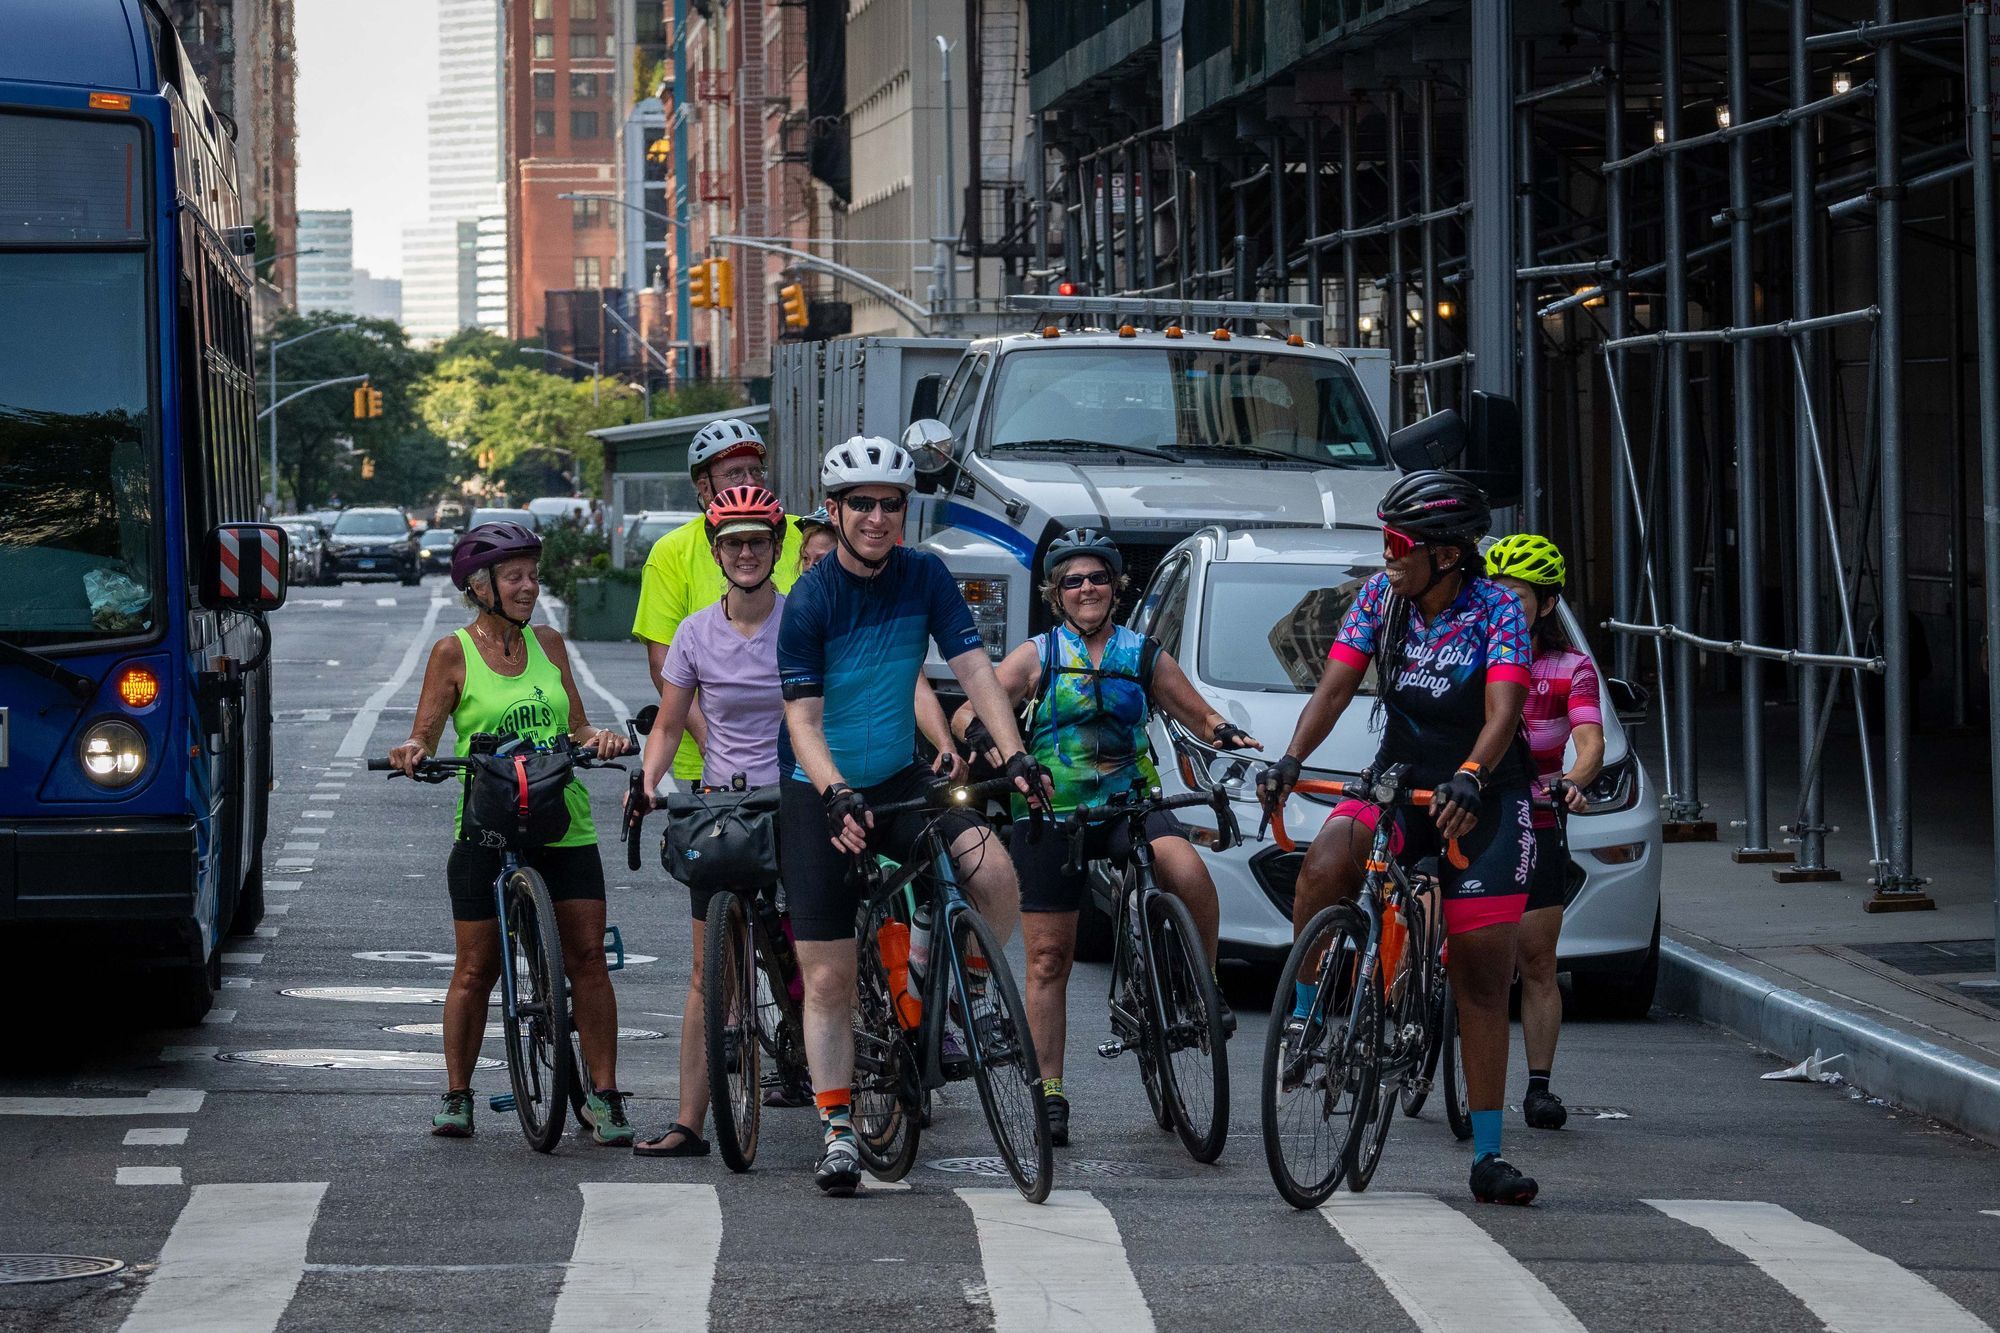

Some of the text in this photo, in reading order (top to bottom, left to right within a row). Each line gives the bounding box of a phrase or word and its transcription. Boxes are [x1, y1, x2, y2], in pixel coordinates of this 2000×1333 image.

[1435, 645, 1473, 670] Girl
[1395, 668, 1451, 698] ycling
[505, 704, 551, 733] GIRLS
[1514, 799, 1534, 885] Sturdy Girl
